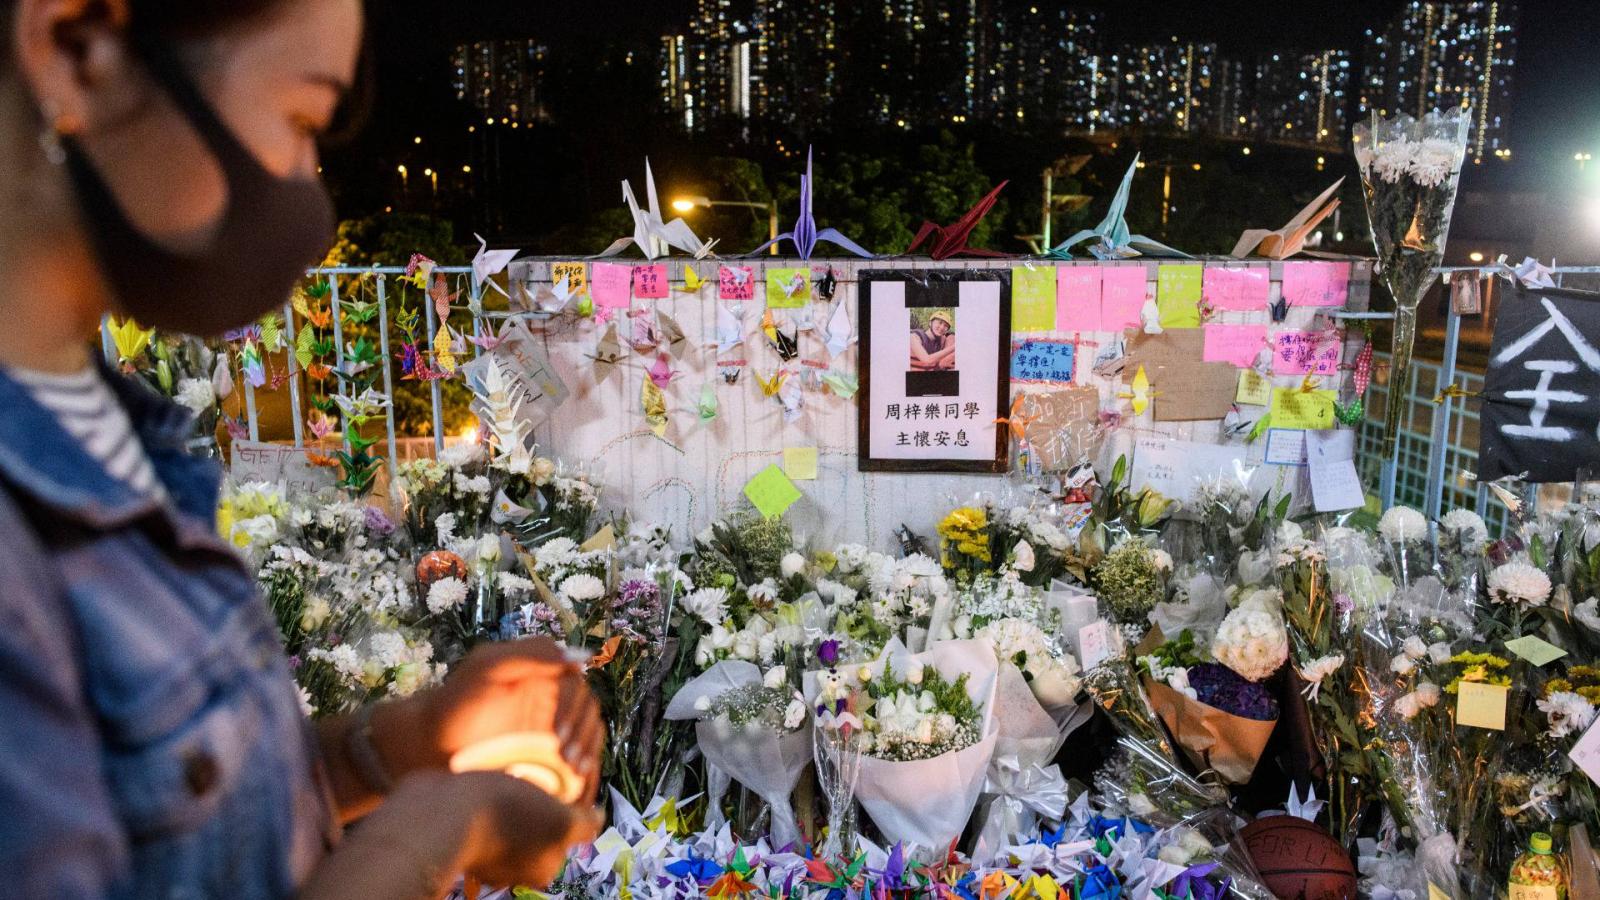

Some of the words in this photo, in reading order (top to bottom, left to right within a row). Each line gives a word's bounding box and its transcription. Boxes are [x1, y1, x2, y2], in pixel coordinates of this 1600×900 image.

[885, 402, 980, 420] 周梓樂同學
[895, 428, 970, 447] 主懷安息
